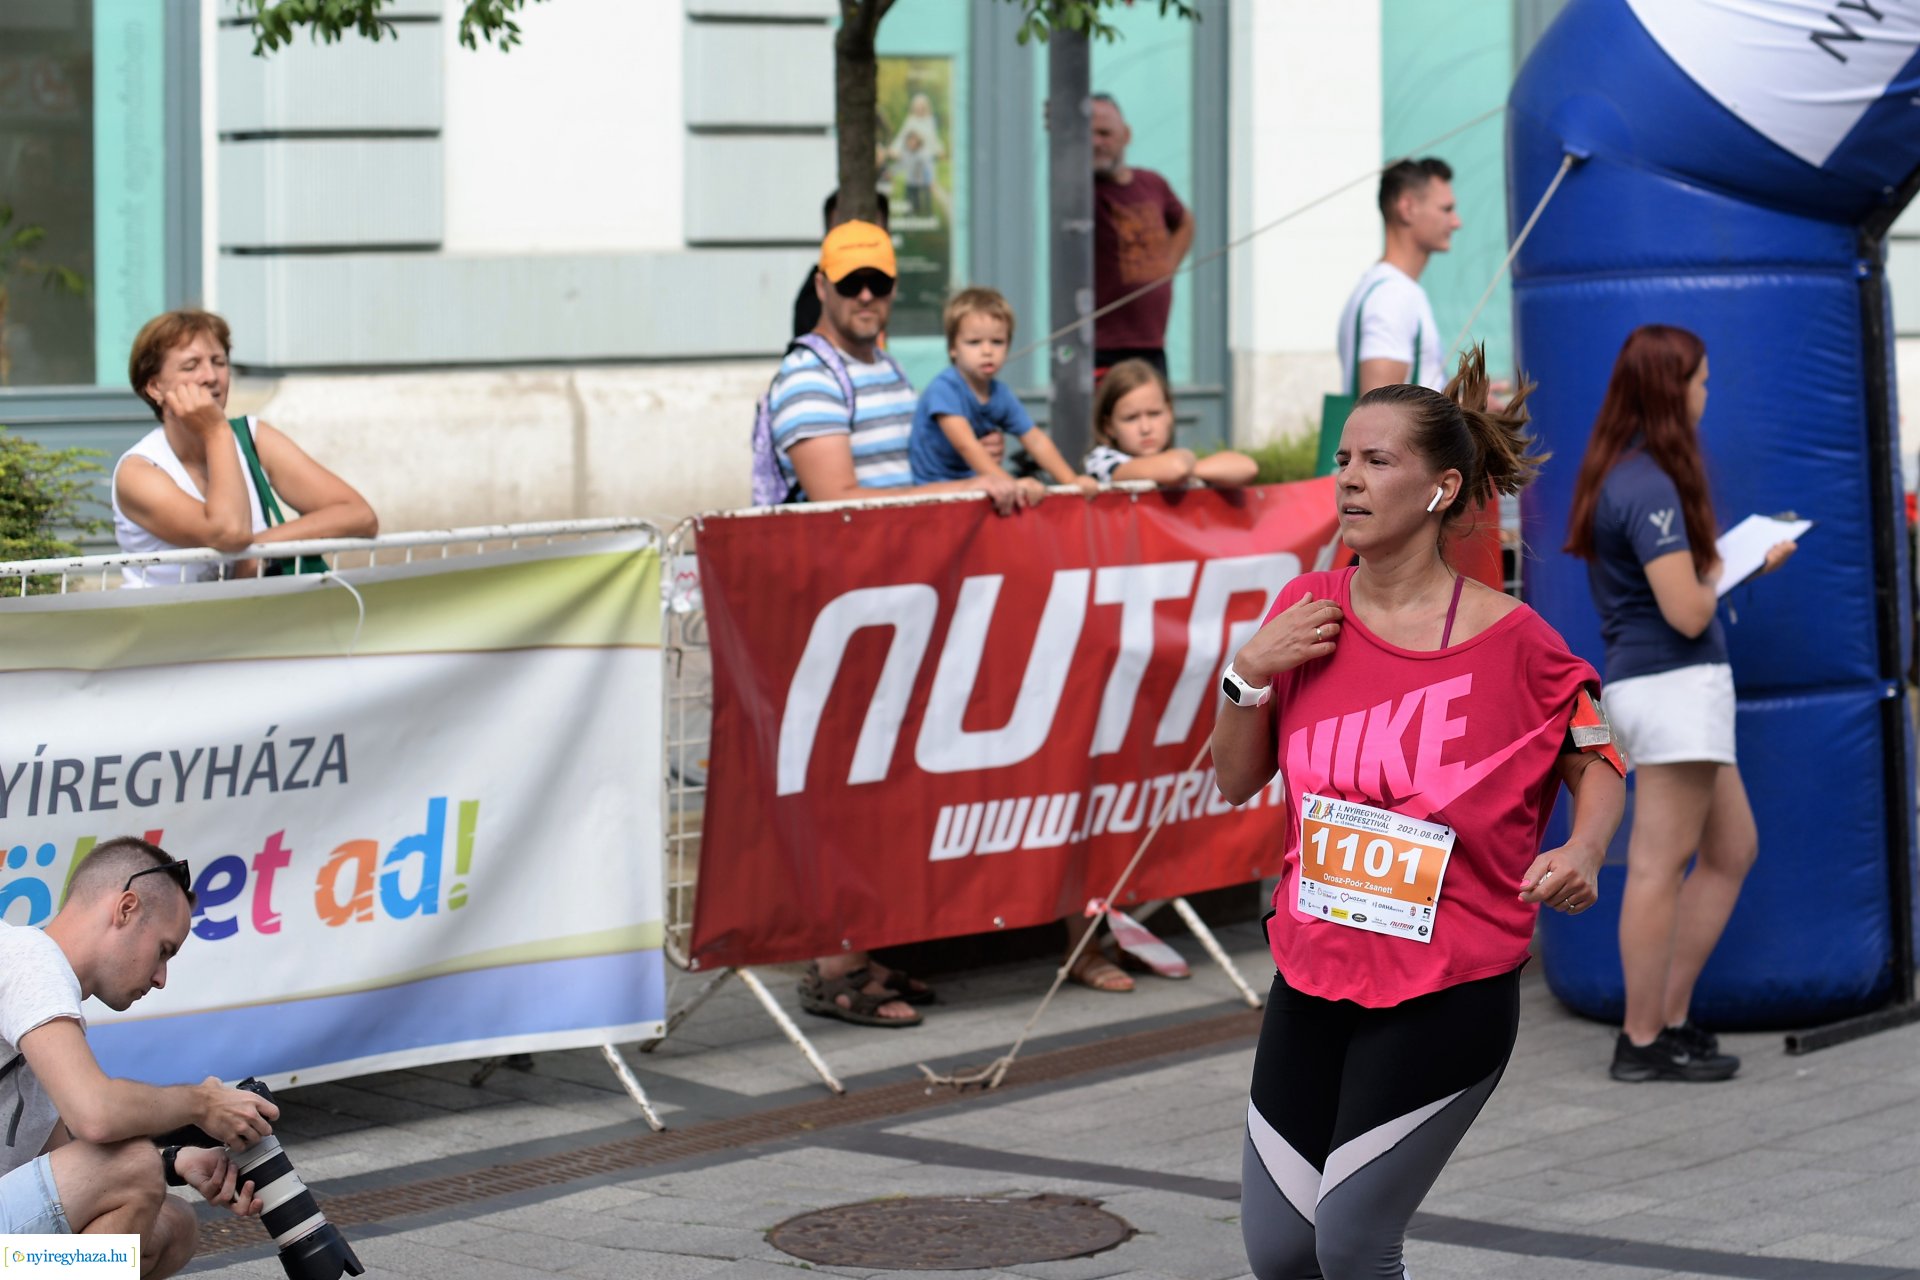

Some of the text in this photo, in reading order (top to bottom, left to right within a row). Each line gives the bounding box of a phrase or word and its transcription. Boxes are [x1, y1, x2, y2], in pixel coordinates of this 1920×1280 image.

[776, 545, 1336, 796] NUTR
[1287, 673, 1472, 803] NIKE
[1343, 805, 1393, 822] NYÍREGYHÁZI
[1396, 823, 1446, 843] 2021.08.08.
[314, 796, 480, 927] ad!
[1311, 827, 1423, 885] 1101
[1364, 881, 1393, 895] Zsanett
